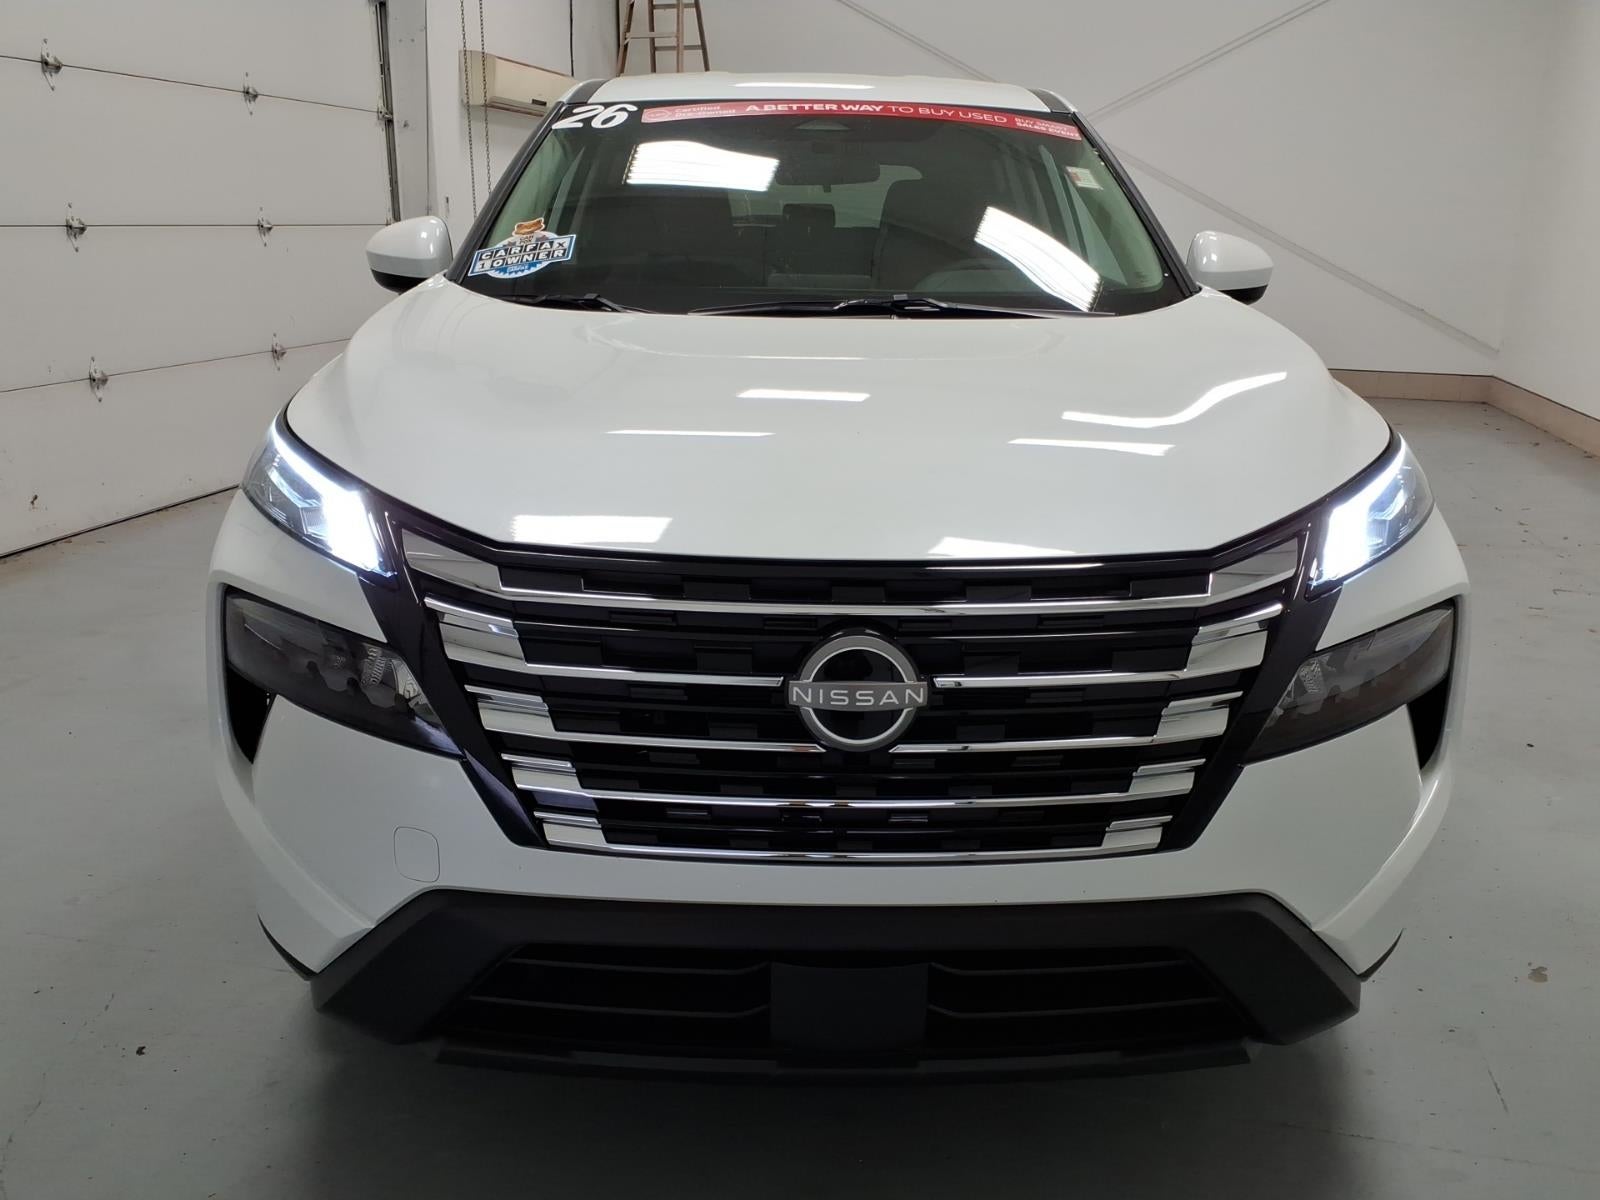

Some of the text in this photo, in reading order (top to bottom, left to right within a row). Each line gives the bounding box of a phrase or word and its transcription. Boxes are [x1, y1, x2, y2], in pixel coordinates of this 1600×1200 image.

[552, 103, 638, 129] 26
[763, 103, 838, 111] BETTER
[841, 104, 884, 112] WAY
[887, 105, 914, 113] TO
[918, 107, 954, 117] BUY
[959, 111, 1008, 123] USED
[481, 241, 567, 260] CARFAX
[492, 249, 565, 268] OWNER
[792, 687, 924, 706] NISSAN
